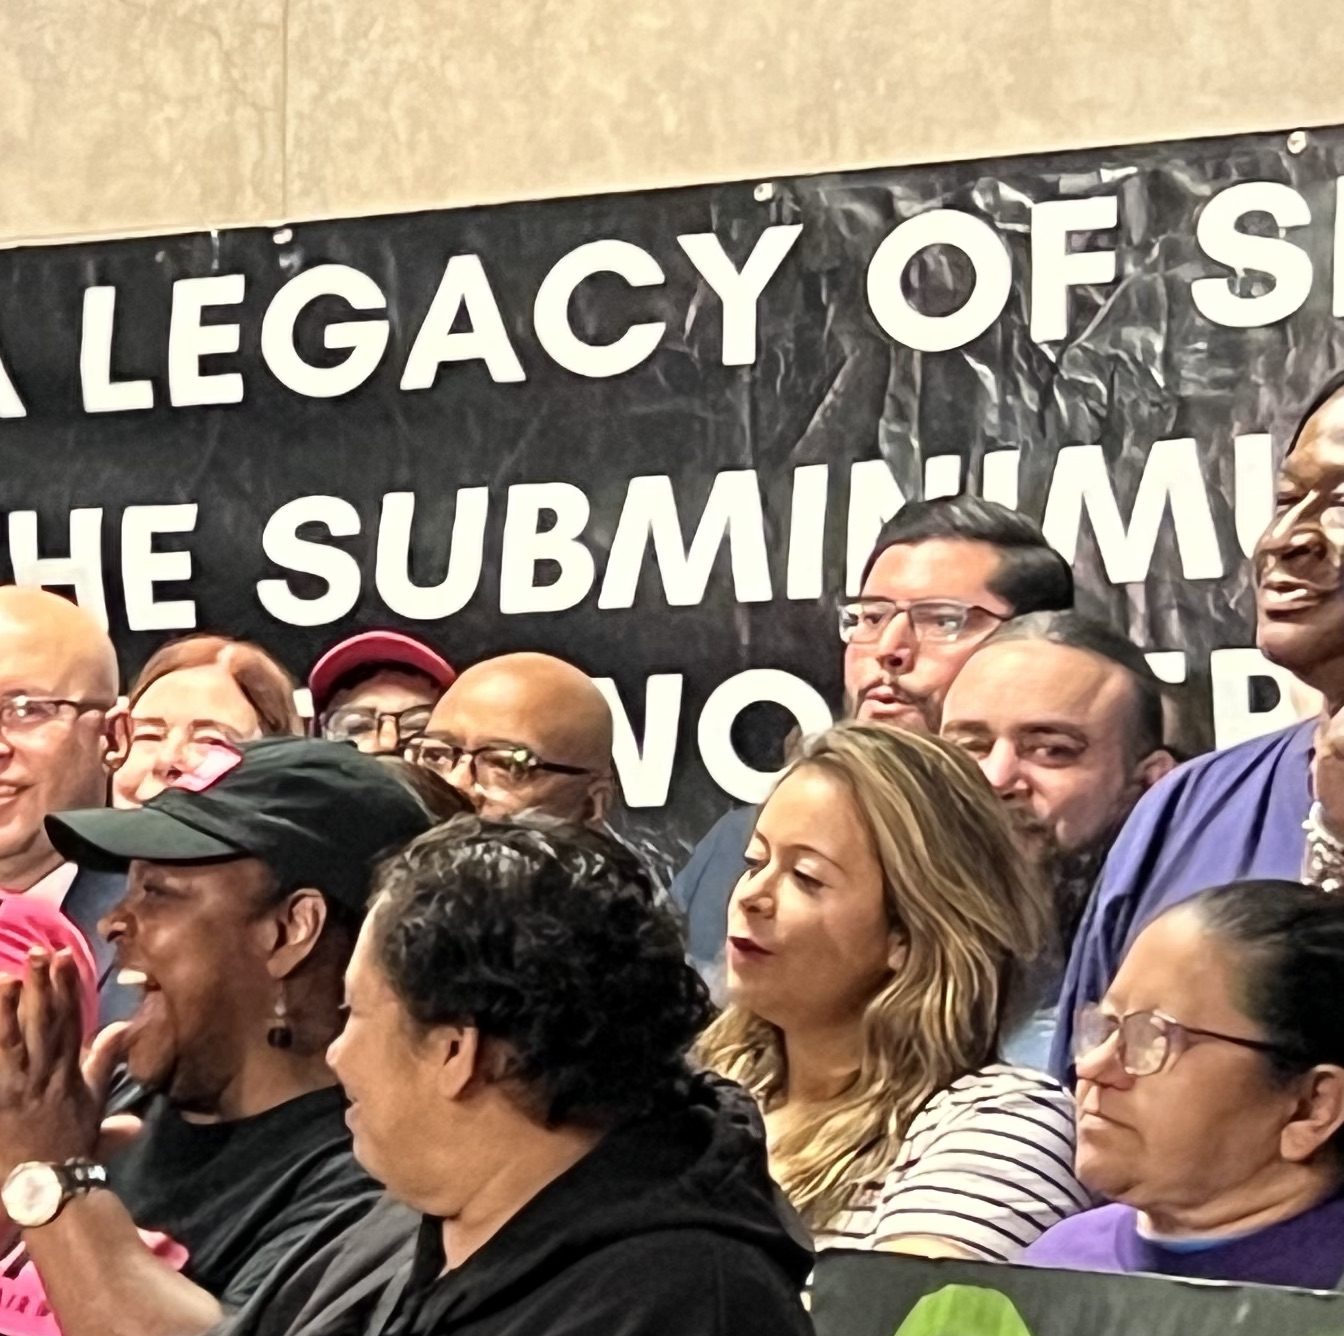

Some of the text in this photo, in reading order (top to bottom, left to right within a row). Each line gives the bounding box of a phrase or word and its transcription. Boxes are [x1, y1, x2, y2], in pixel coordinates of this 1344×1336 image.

[80, 222, 803, 413] LEGACY
[866, 196, 1118, 352] OF
[1191, 175, 1344, 328] S
[256, 433, 1275, 626] SUBMINM
